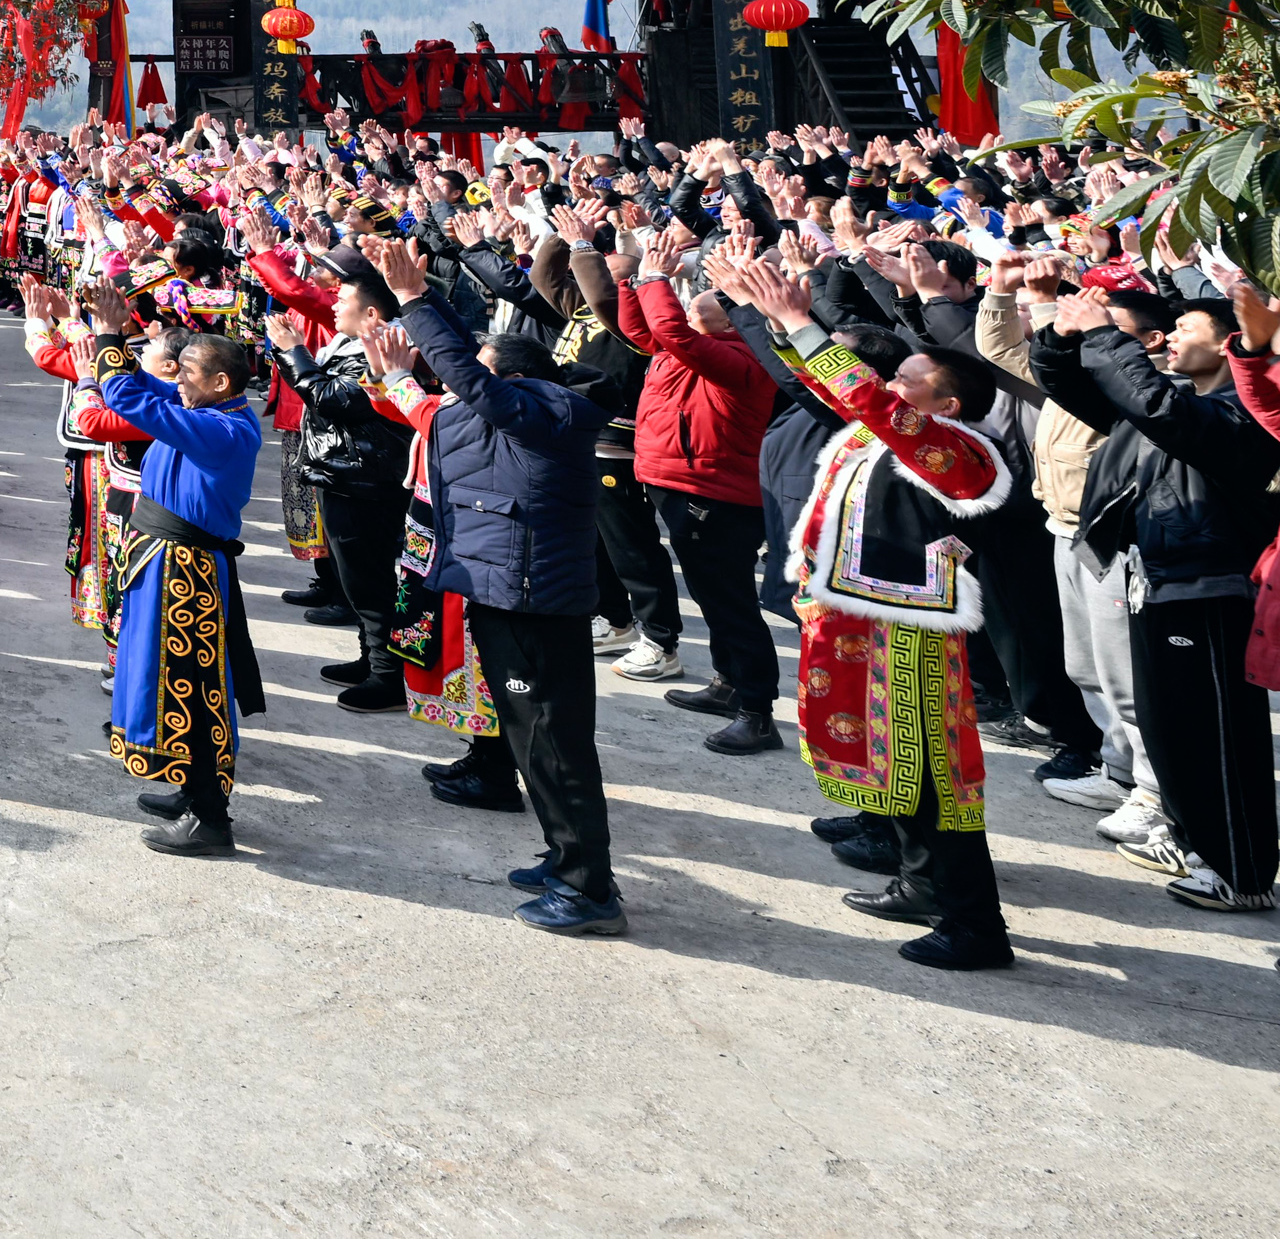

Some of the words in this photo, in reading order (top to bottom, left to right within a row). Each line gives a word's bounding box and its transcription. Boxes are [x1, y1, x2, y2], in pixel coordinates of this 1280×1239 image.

[179, 38, 229, 49] 木梯年久
[179, 49, 231, 60] 禁止攀爬
[179, 60, 229, 70] 后果自负
